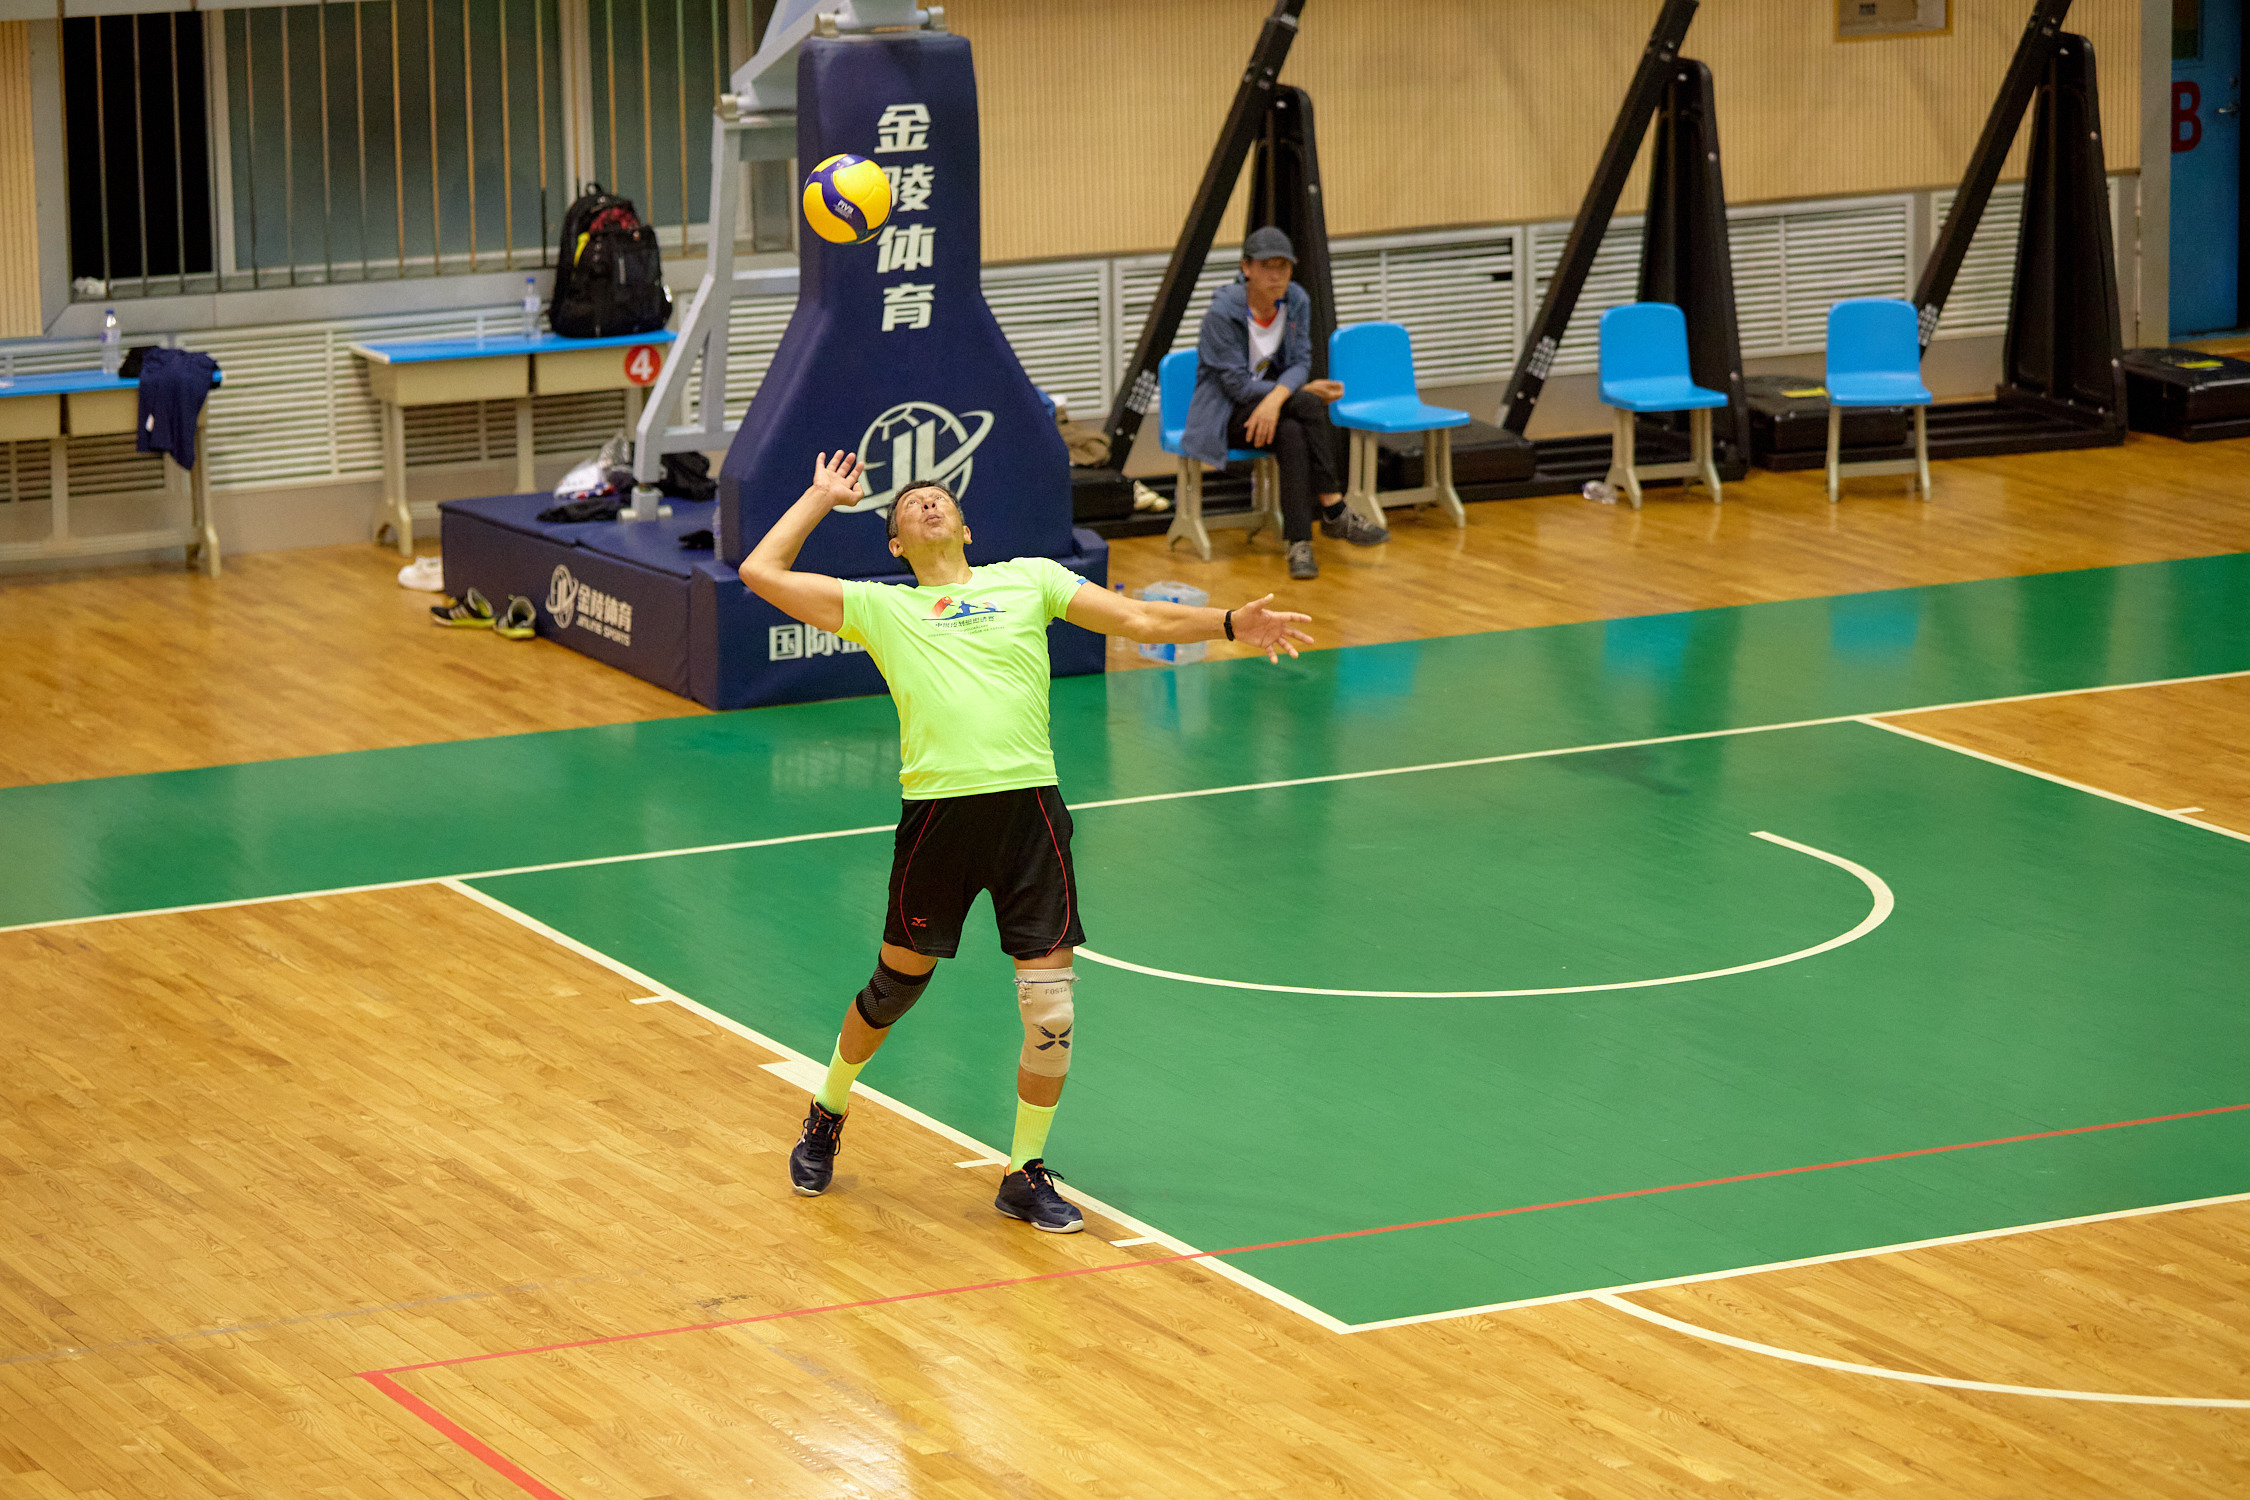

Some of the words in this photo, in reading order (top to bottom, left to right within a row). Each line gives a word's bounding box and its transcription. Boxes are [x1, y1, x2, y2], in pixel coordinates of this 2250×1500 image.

[2171, 80, 2202, 154] B
[874, 102, 936, 333] 金陵体育
[630, 347, 655, 381] 4
[576, 582, 633, 633] 金陵体育
